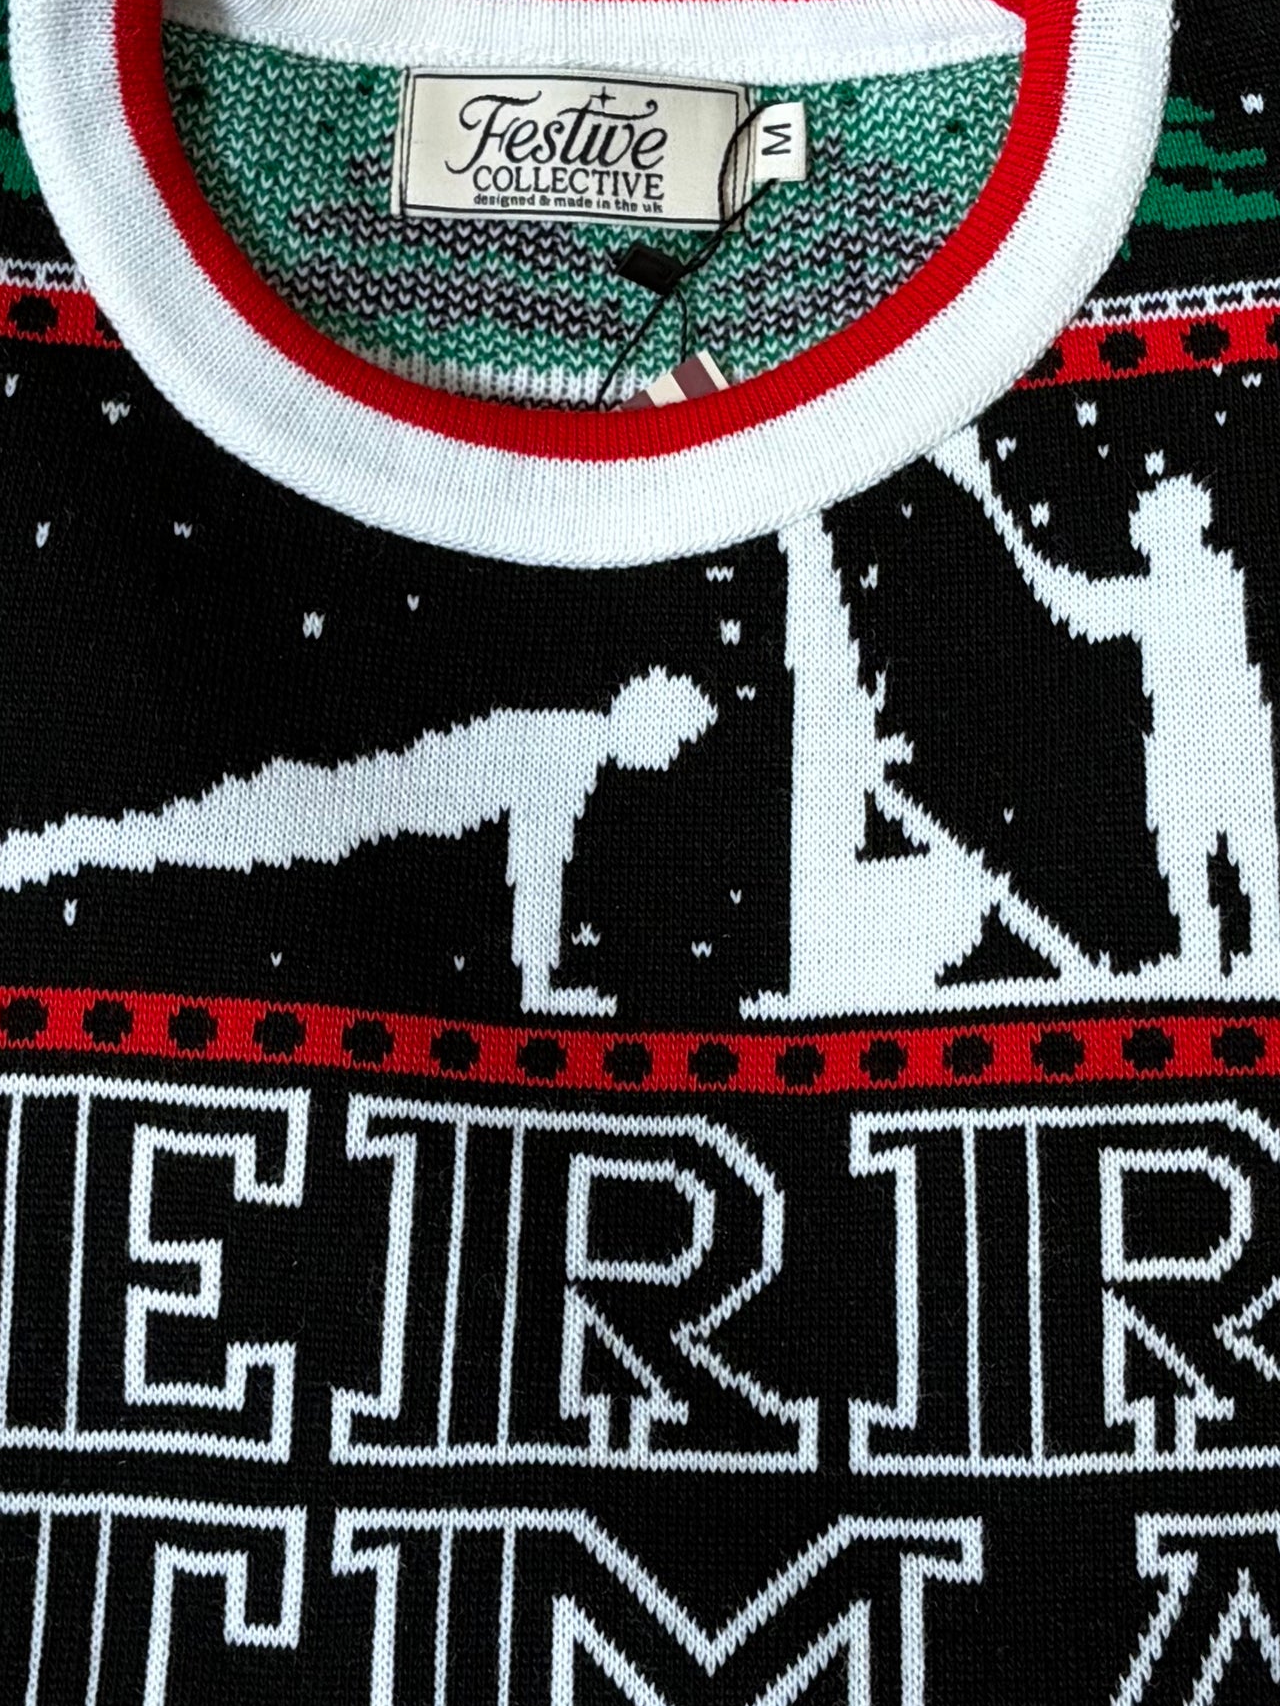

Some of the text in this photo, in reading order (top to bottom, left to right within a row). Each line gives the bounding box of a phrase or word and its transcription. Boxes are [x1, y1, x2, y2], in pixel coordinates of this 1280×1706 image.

[444, 86, 668, 175] Festive
[761, 123, 792, 156] M
[472, 165, 665, 200] COLLECTIVE
[473, 194, 664, 214] designed & made in the uk
